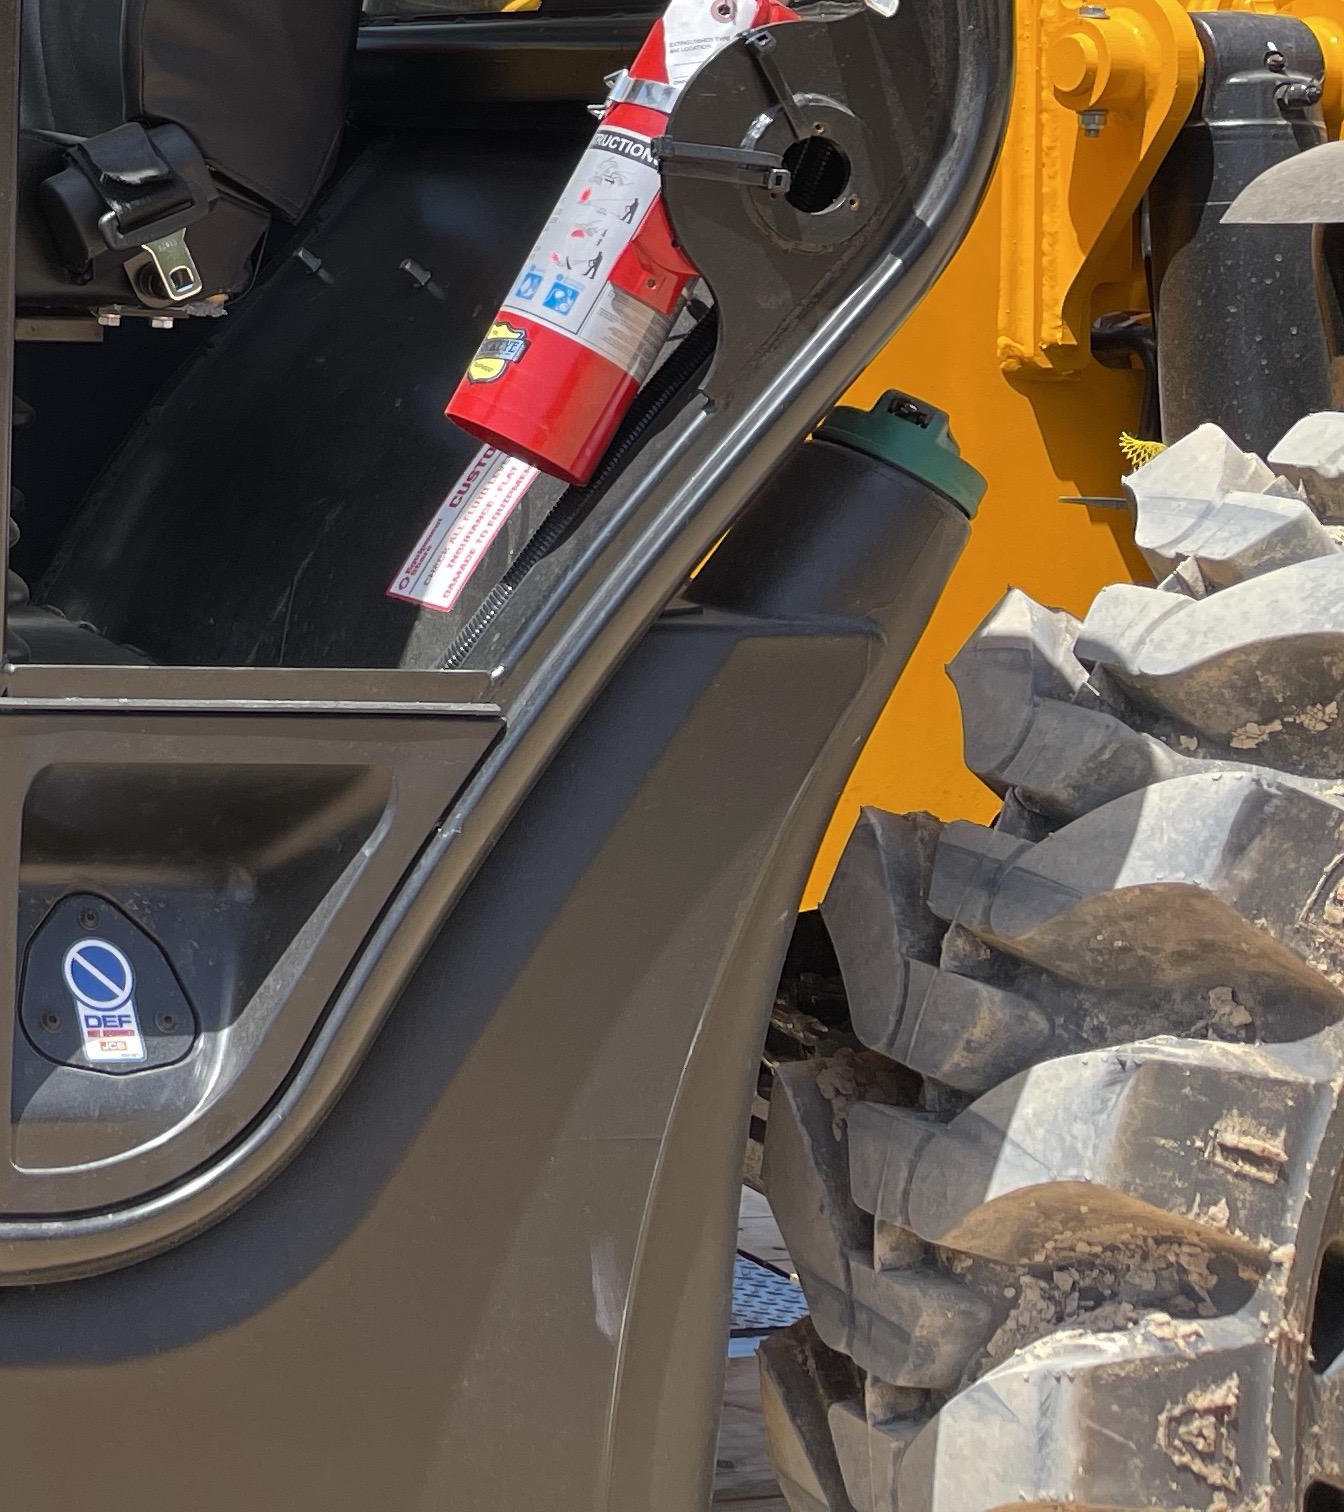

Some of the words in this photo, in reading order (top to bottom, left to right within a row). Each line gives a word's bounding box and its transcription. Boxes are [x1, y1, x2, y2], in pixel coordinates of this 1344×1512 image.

[405, 517, 443, 576] Equipment
[410, 543, 433, 577] Share
[83, 1014, 133, 1028] DEF
